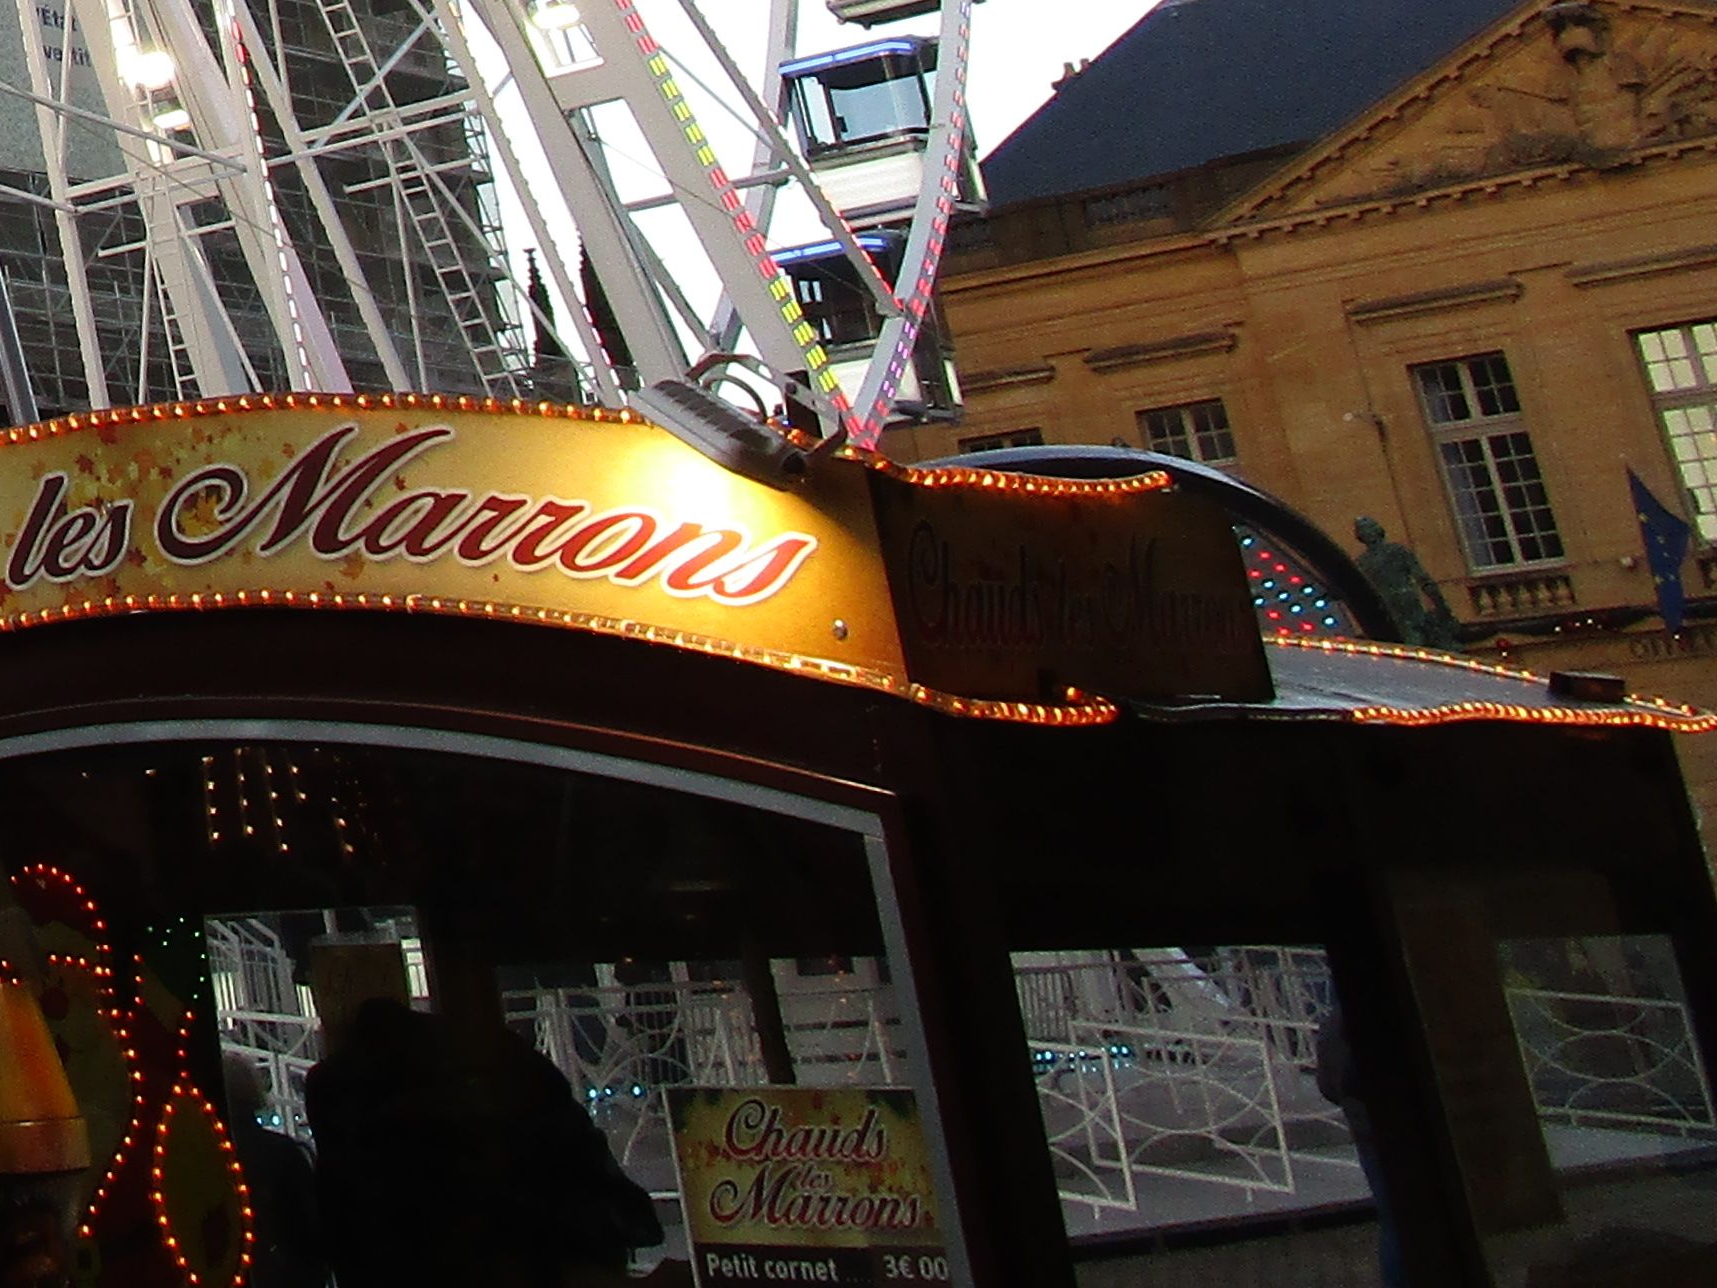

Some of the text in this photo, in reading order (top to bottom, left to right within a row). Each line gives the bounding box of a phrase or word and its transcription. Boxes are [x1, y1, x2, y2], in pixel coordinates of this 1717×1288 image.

[6, 471, 133, 590] les
[155, 424, 818, 606] Marrons
[908, 517, 1044, 648] Chauds
[724, 1096, 888, 1162] Chauds
[708, 1164, 921, 1230] Marrons
[797, 1164, 833, 1191] les
[705, 1252, 760, 1279] Petit
[764, 1256, 839, 1283] cornet
